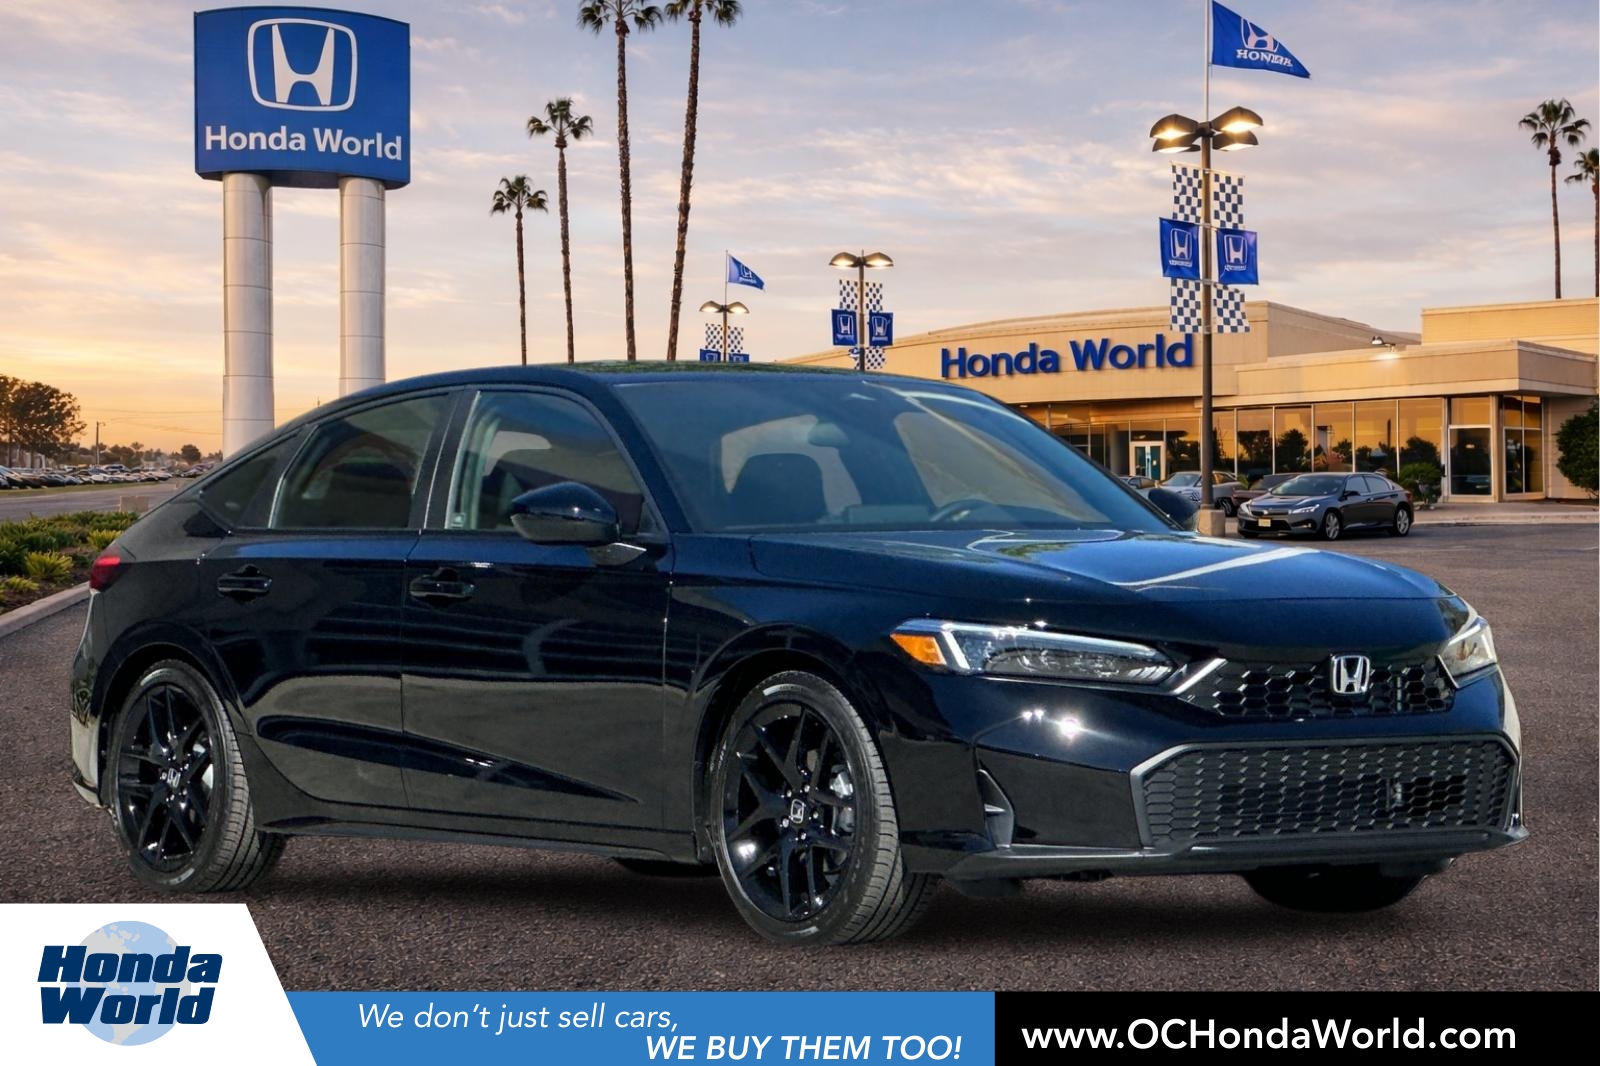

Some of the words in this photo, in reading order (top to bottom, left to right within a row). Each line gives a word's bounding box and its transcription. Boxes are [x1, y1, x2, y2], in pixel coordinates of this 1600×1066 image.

[205, 125, 306, 151] Honda
[313, 128, 402, 161] World
[941, 343, 1060, 377] Honda
[1069, 333, 1194, 371] World
